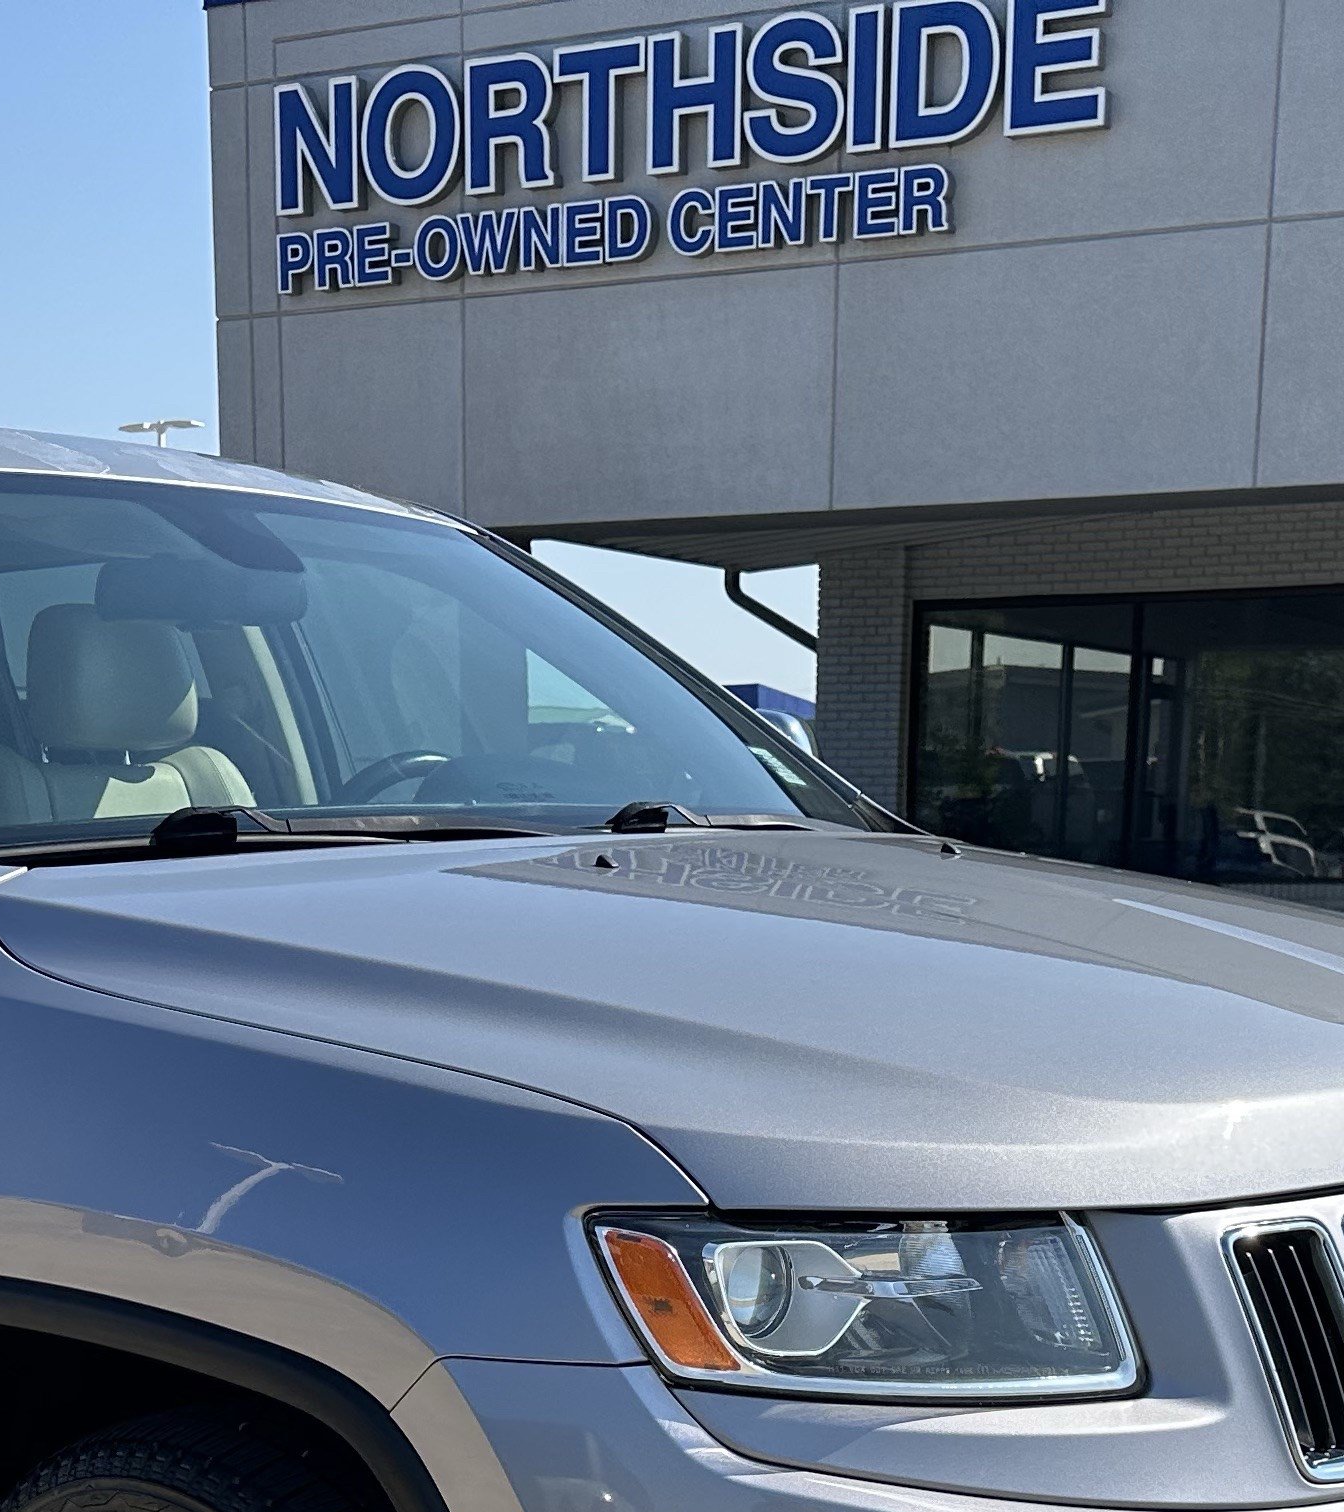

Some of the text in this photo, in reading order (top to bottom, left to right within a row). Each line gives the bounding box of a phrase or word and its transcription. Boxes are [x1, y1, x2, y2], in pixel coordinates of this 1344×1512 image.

[274, 0, 1108, 216] NORTHSIDE
[276, 163, 951, 295] PRE-OWNED CENTER
